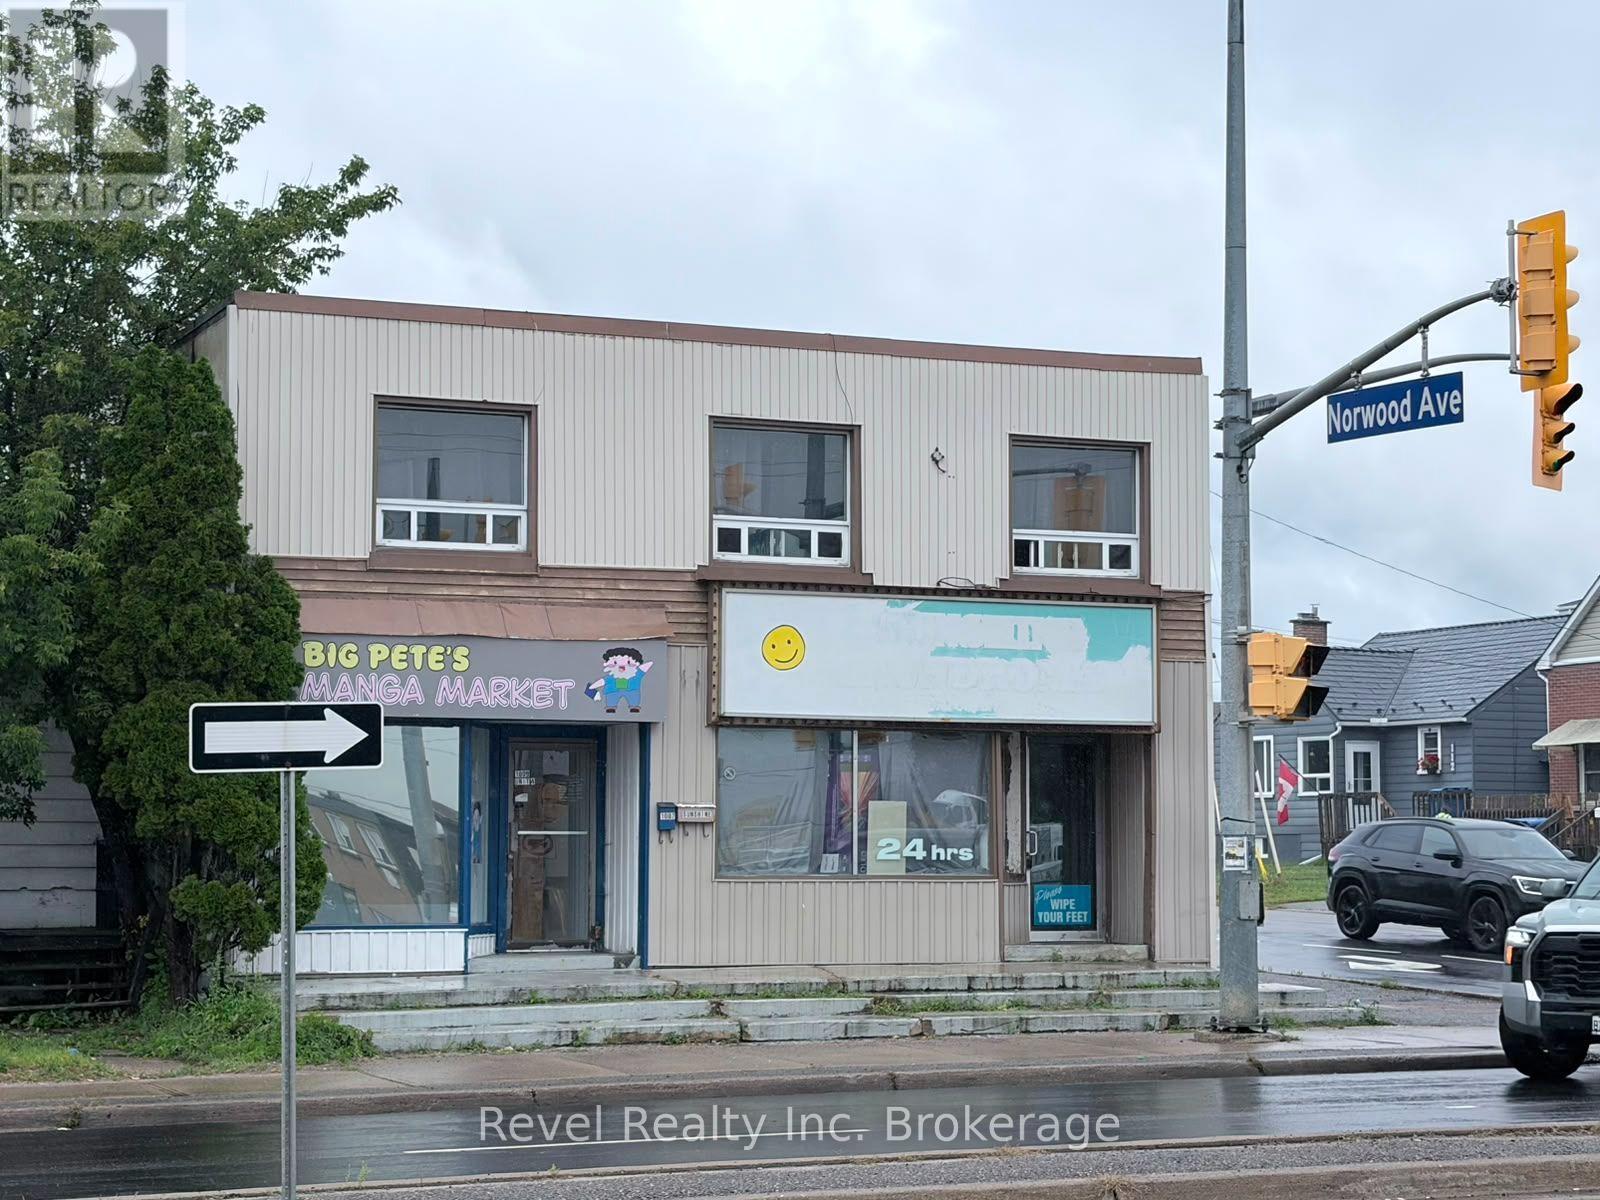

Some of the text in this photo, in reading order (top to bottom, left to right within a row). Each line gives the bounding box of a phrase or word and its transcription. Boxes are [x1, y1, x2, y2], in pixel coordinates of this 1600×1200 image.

[1328, 386, 1462, 435] Norwood Ave
[302, 640, 471, 672] BIG PETE'S
[300, 672, 576, 710] MANGA MARKET
[876, 838, 974, 861] 24 hrs
[1037, 911, 1088, 923] YOUR FEET
[1050, 898, 1076, 910] WIPE
